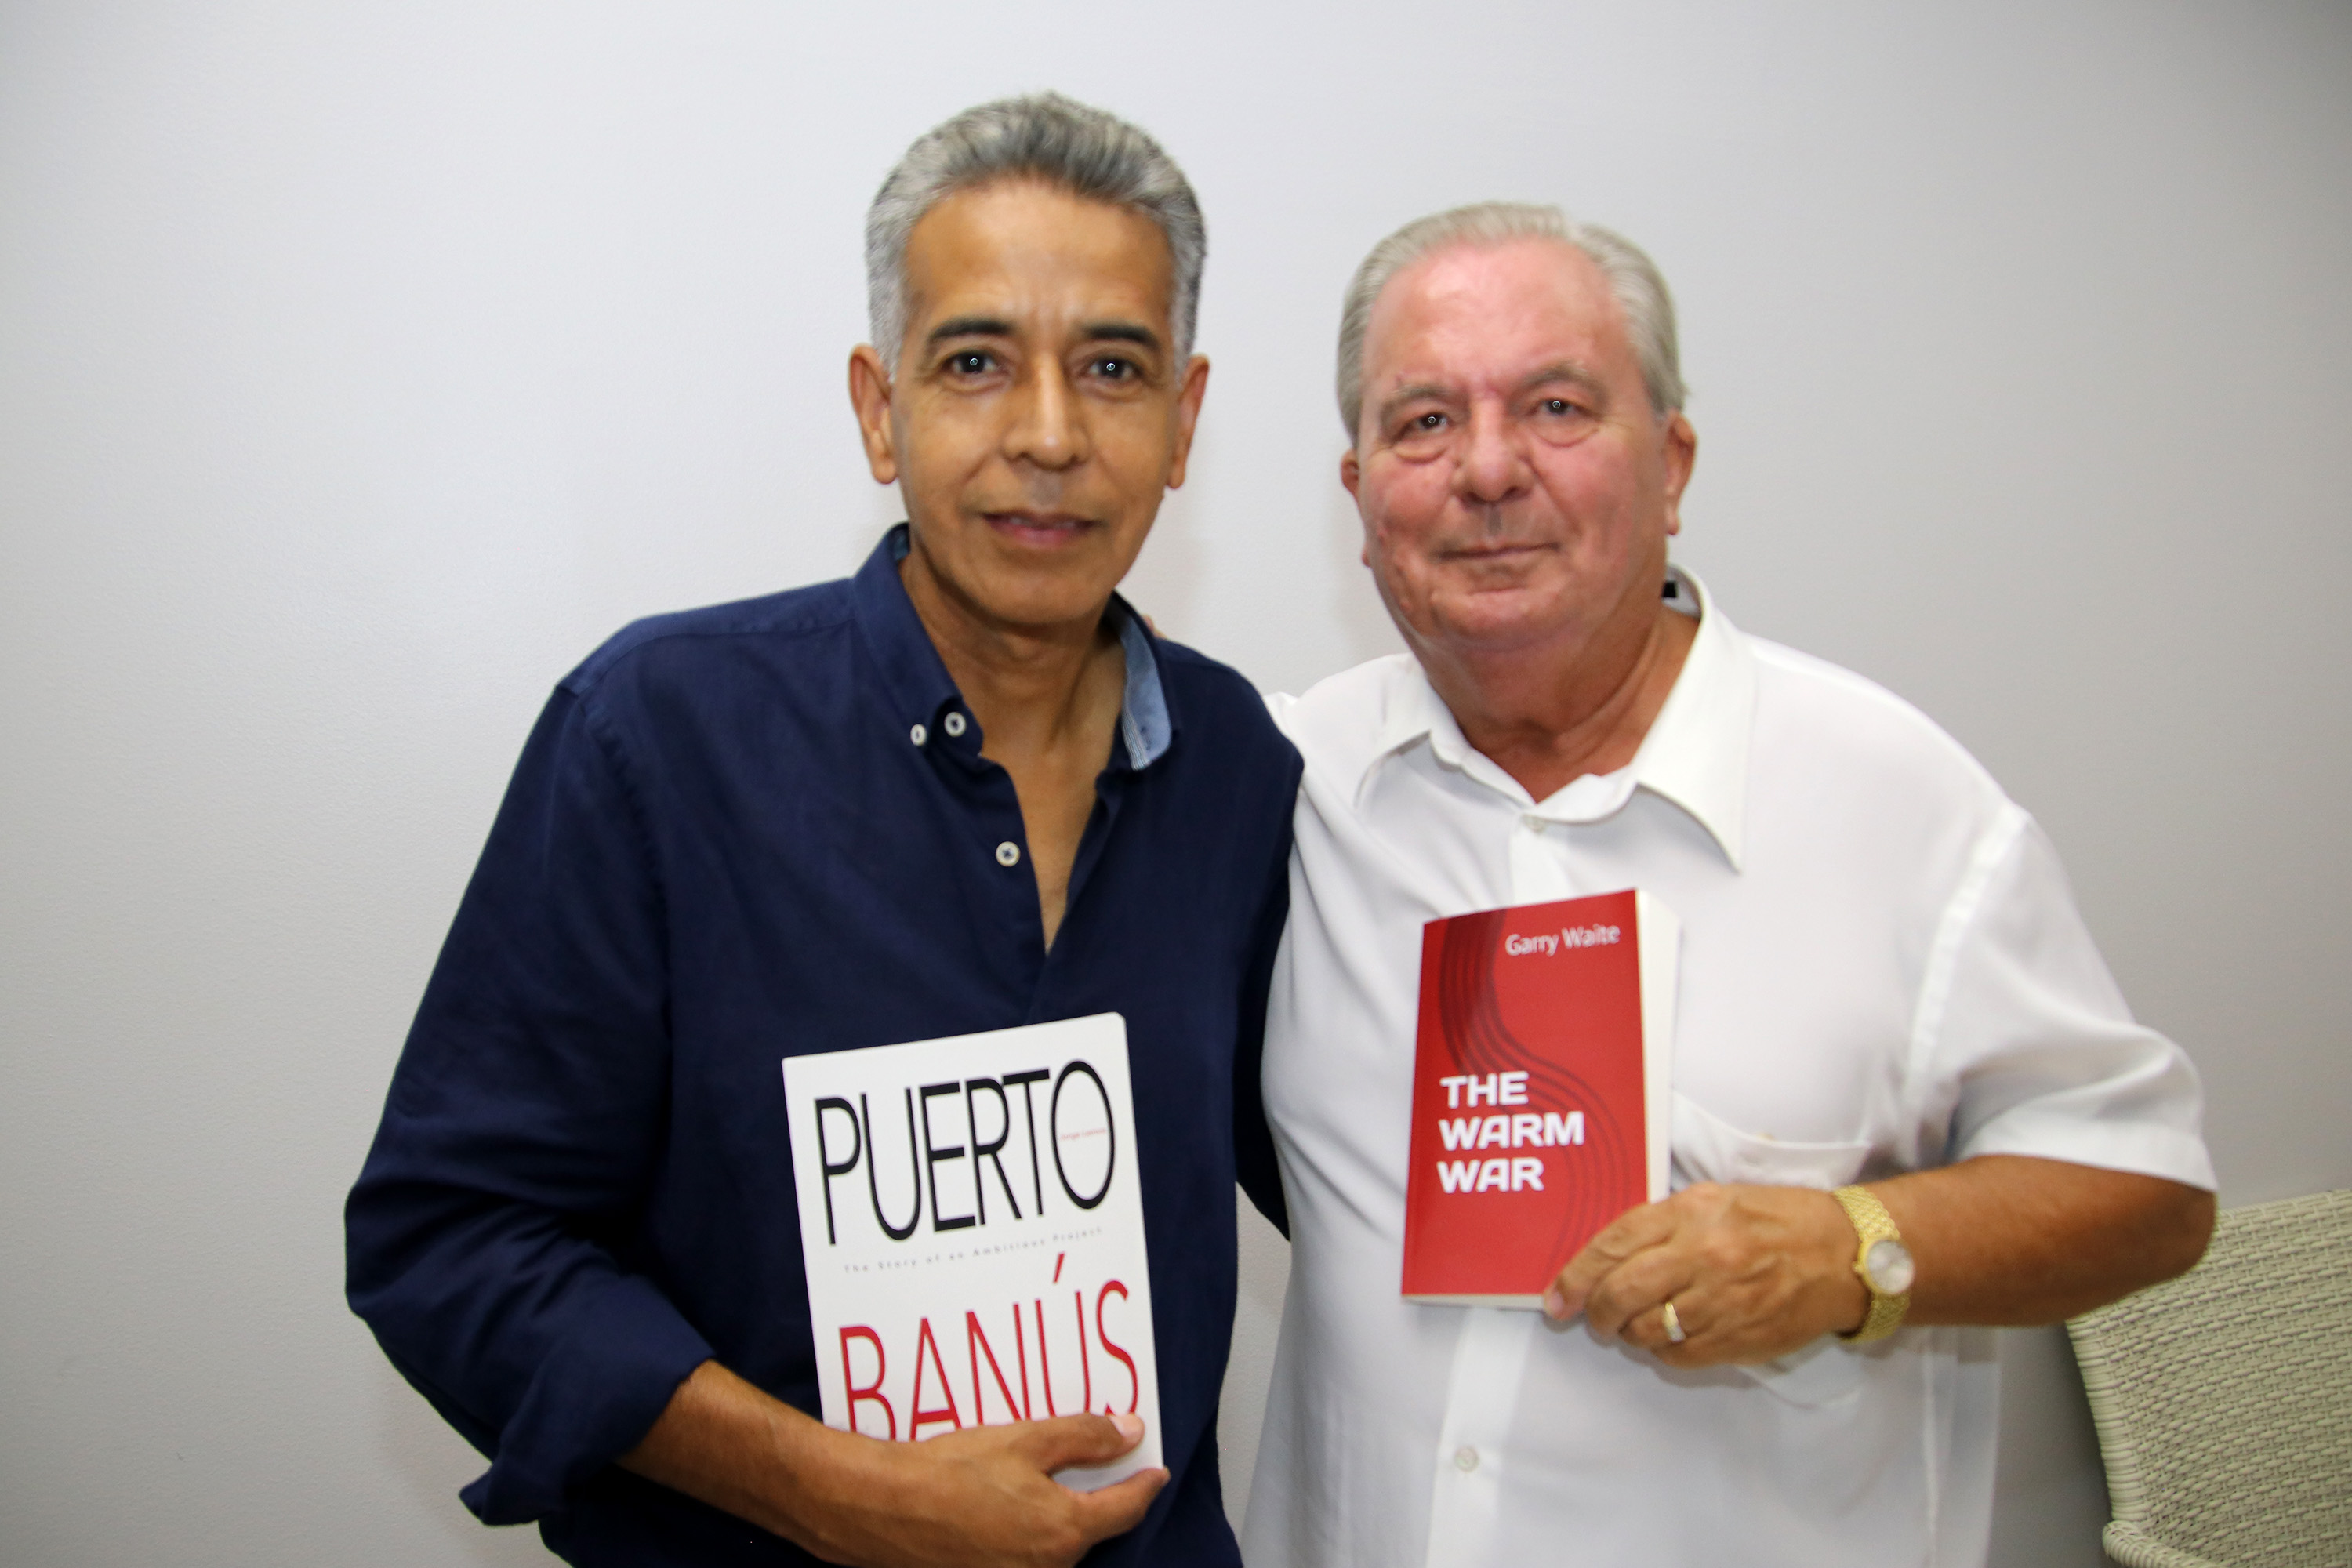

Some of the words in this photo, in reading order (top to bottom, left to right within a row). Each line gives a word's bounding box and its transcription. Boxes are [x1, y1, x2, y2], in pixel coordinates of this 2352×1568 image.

[1504, 933, 1559, 956] Garry
[1561, 923, 1621, 949] Waite
[1439, 1070, 1530, 1109] THE
[1437, 1110, 1585, 1152] WARM
[814, 1059, 1116, 1247] PUERTO
[1436, 1156, 1545, 1195] WAR
[844, 1263, 869, 1274] The
[877, 1258, 916, 1271] Story
[925, 1253, 940, 1265] of
[948, 1250, 964, 1261] an
[972, 1238, 1046, 1257] Ambitious
[1052, 1225, 1102, 1243] Project
[839, 1252, 1139, 1442] BANÚS
